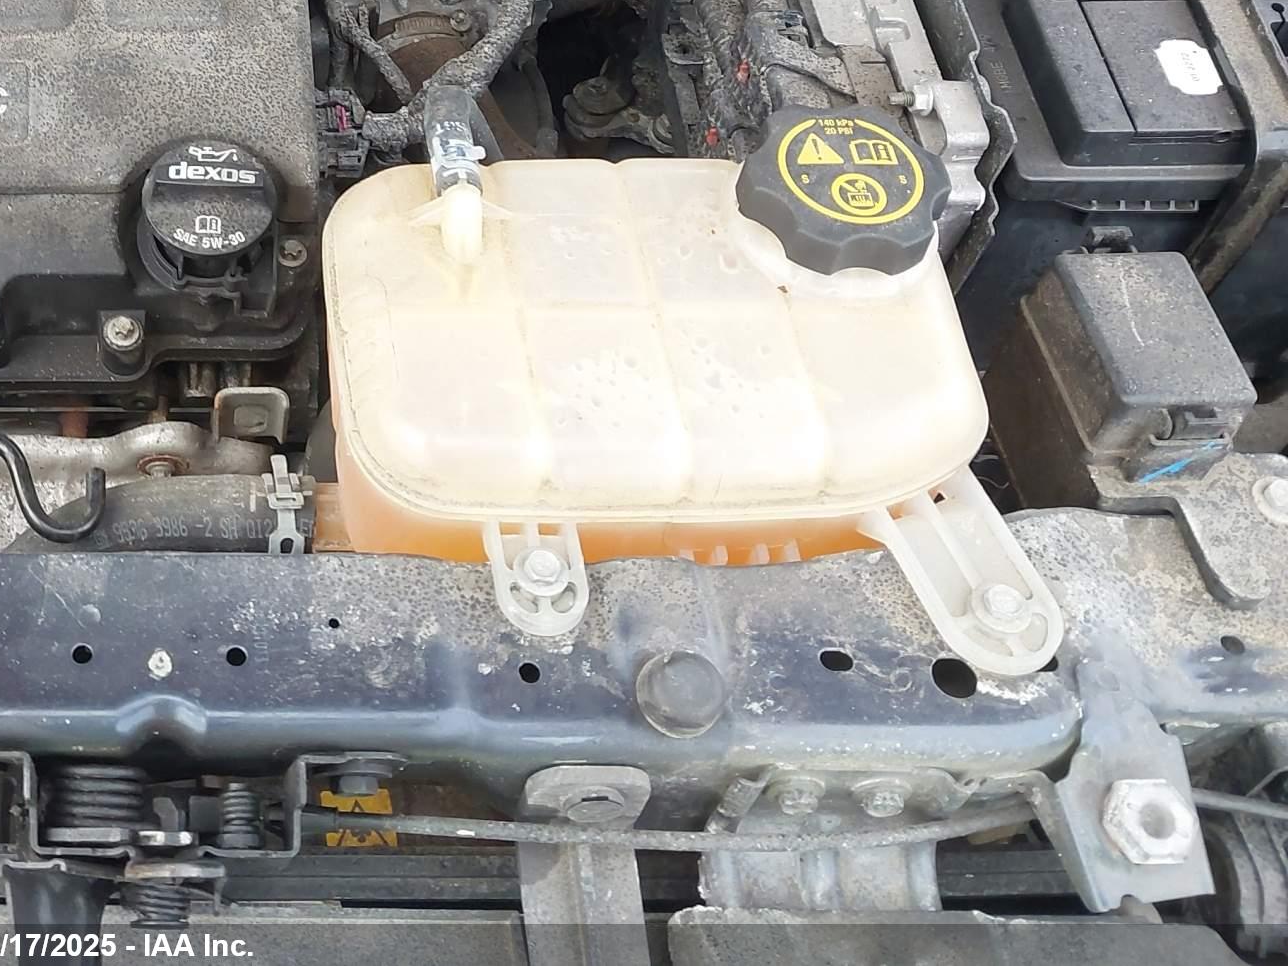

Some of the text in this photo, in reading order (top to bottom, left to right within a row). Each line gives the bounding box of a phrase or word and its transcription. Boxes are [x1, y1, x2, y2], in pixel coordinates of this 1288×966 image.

[836, 119, 854, 127] kPa
[168, 162, 259, 184] dexos
[173, 228, 246, 249] SAE 5W-30
